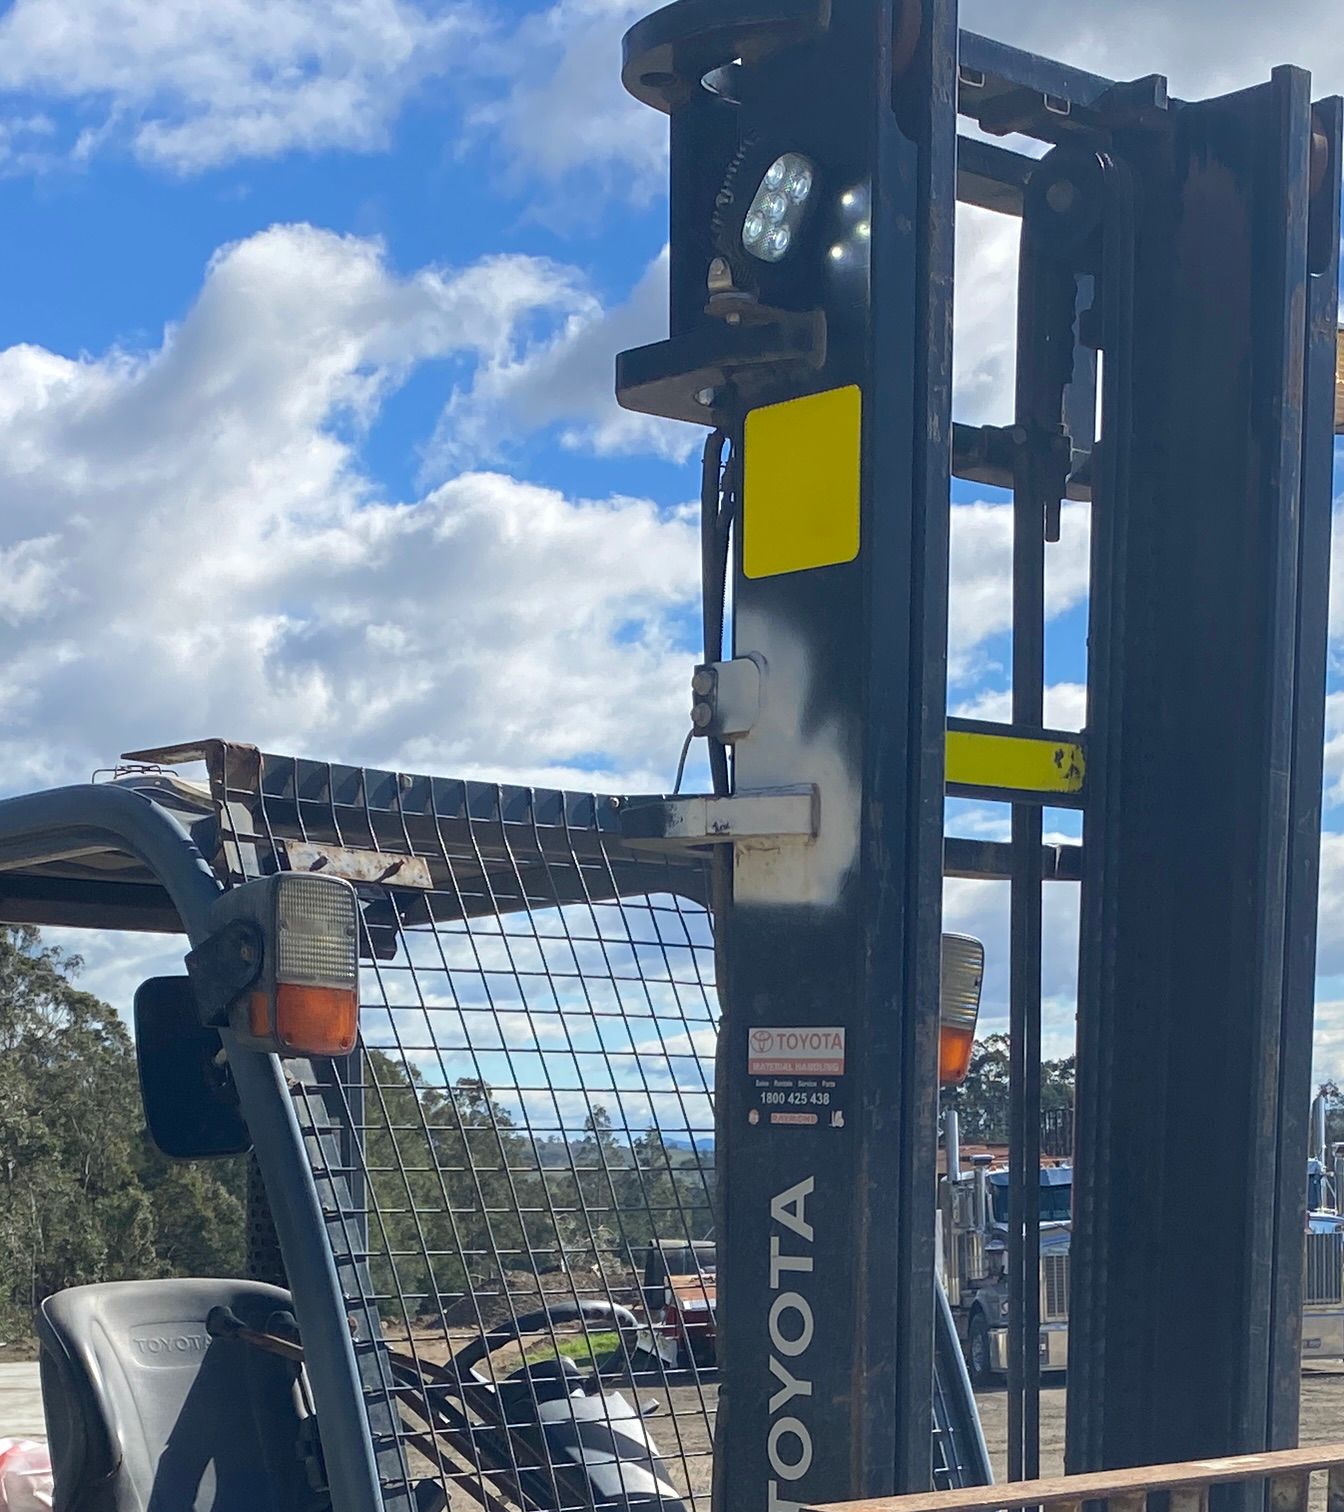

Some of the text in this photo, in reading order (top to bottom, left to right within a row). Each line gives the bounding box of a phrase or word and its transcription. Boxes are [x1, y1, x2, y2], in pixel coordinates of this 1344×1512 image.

[777, 1033, 843, 1050] TOYOTA
[752, 1062, 839, 1072] MATERIAL HANDLING
[760, 1092, 830, 1105] 1800 425 438
